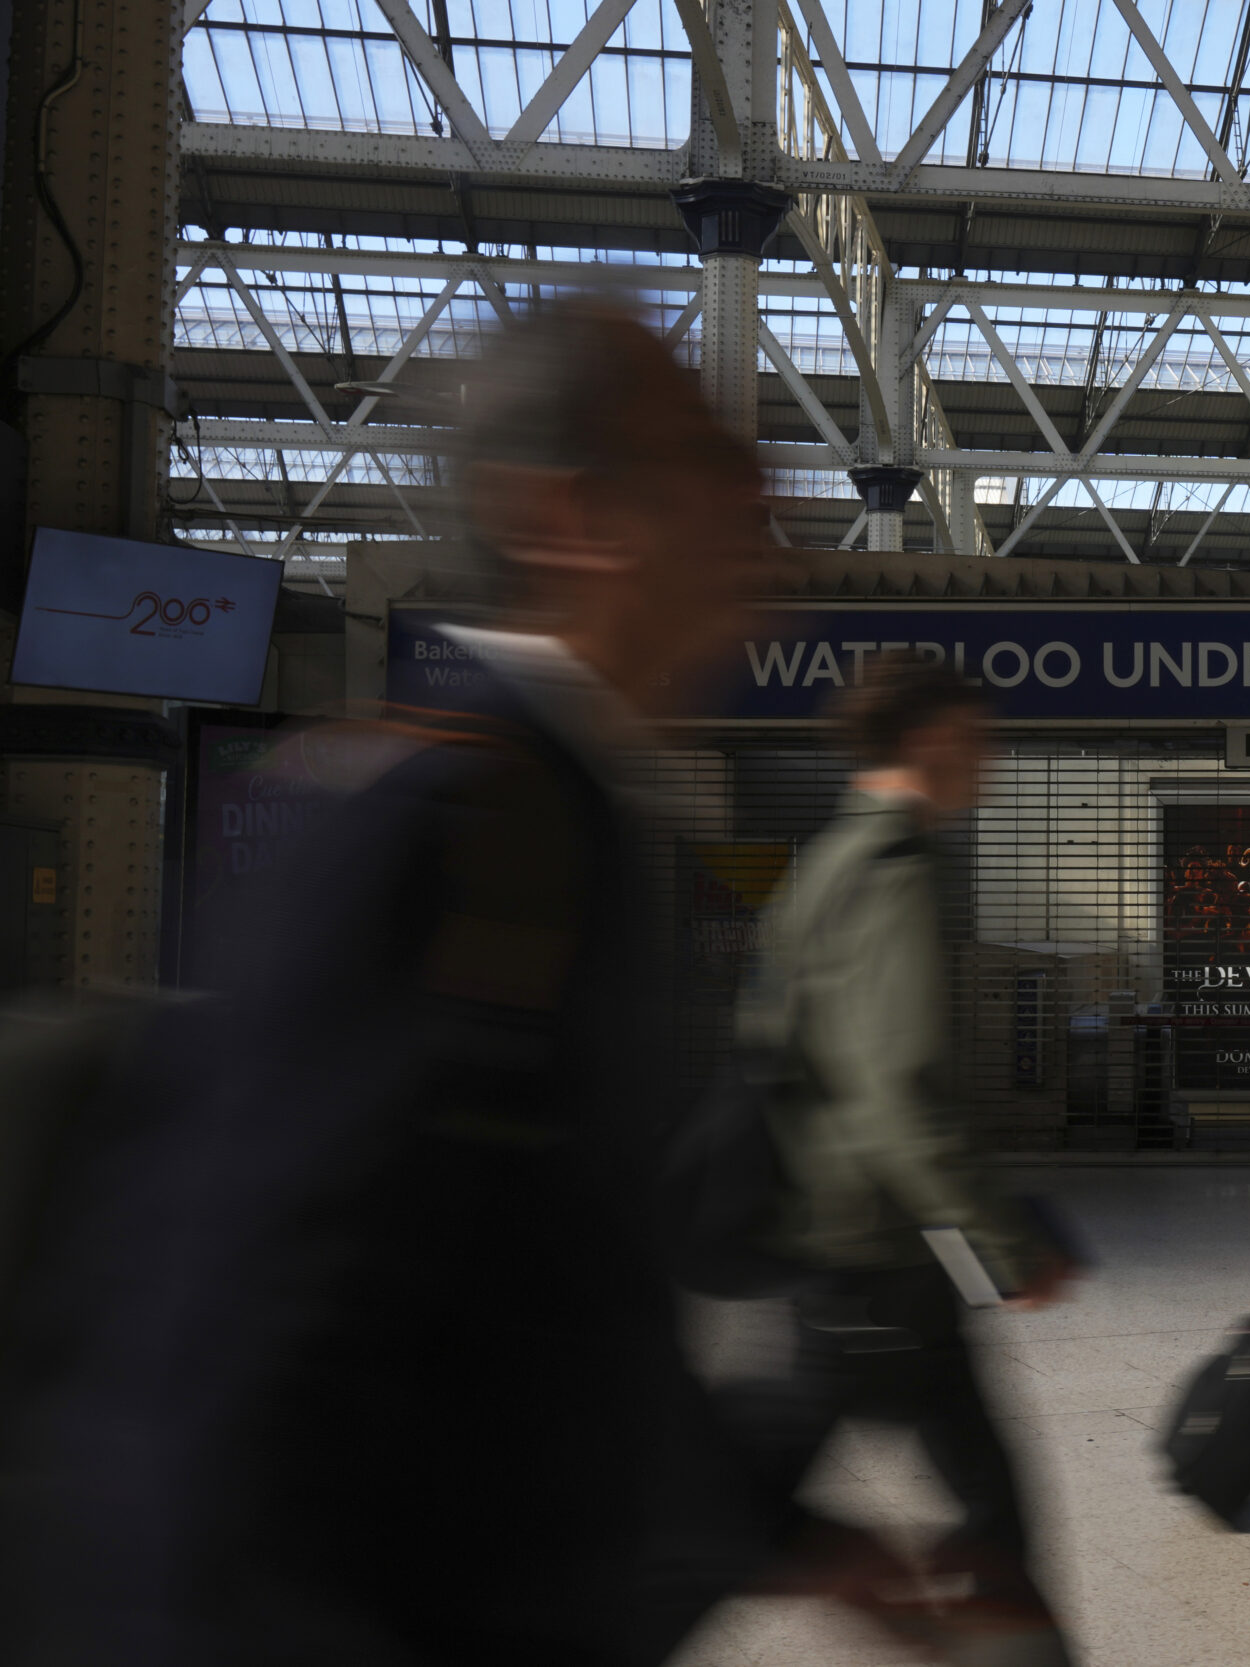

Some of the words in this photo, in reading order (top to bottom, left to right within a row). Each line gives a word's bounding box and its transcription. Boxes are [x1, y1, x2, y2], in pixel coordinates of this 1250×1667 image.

[425, 667, 486, 686] Wate
[1172, 970, 1202, 982] THE
[1182, 1004, 1219, 1016] THIS
